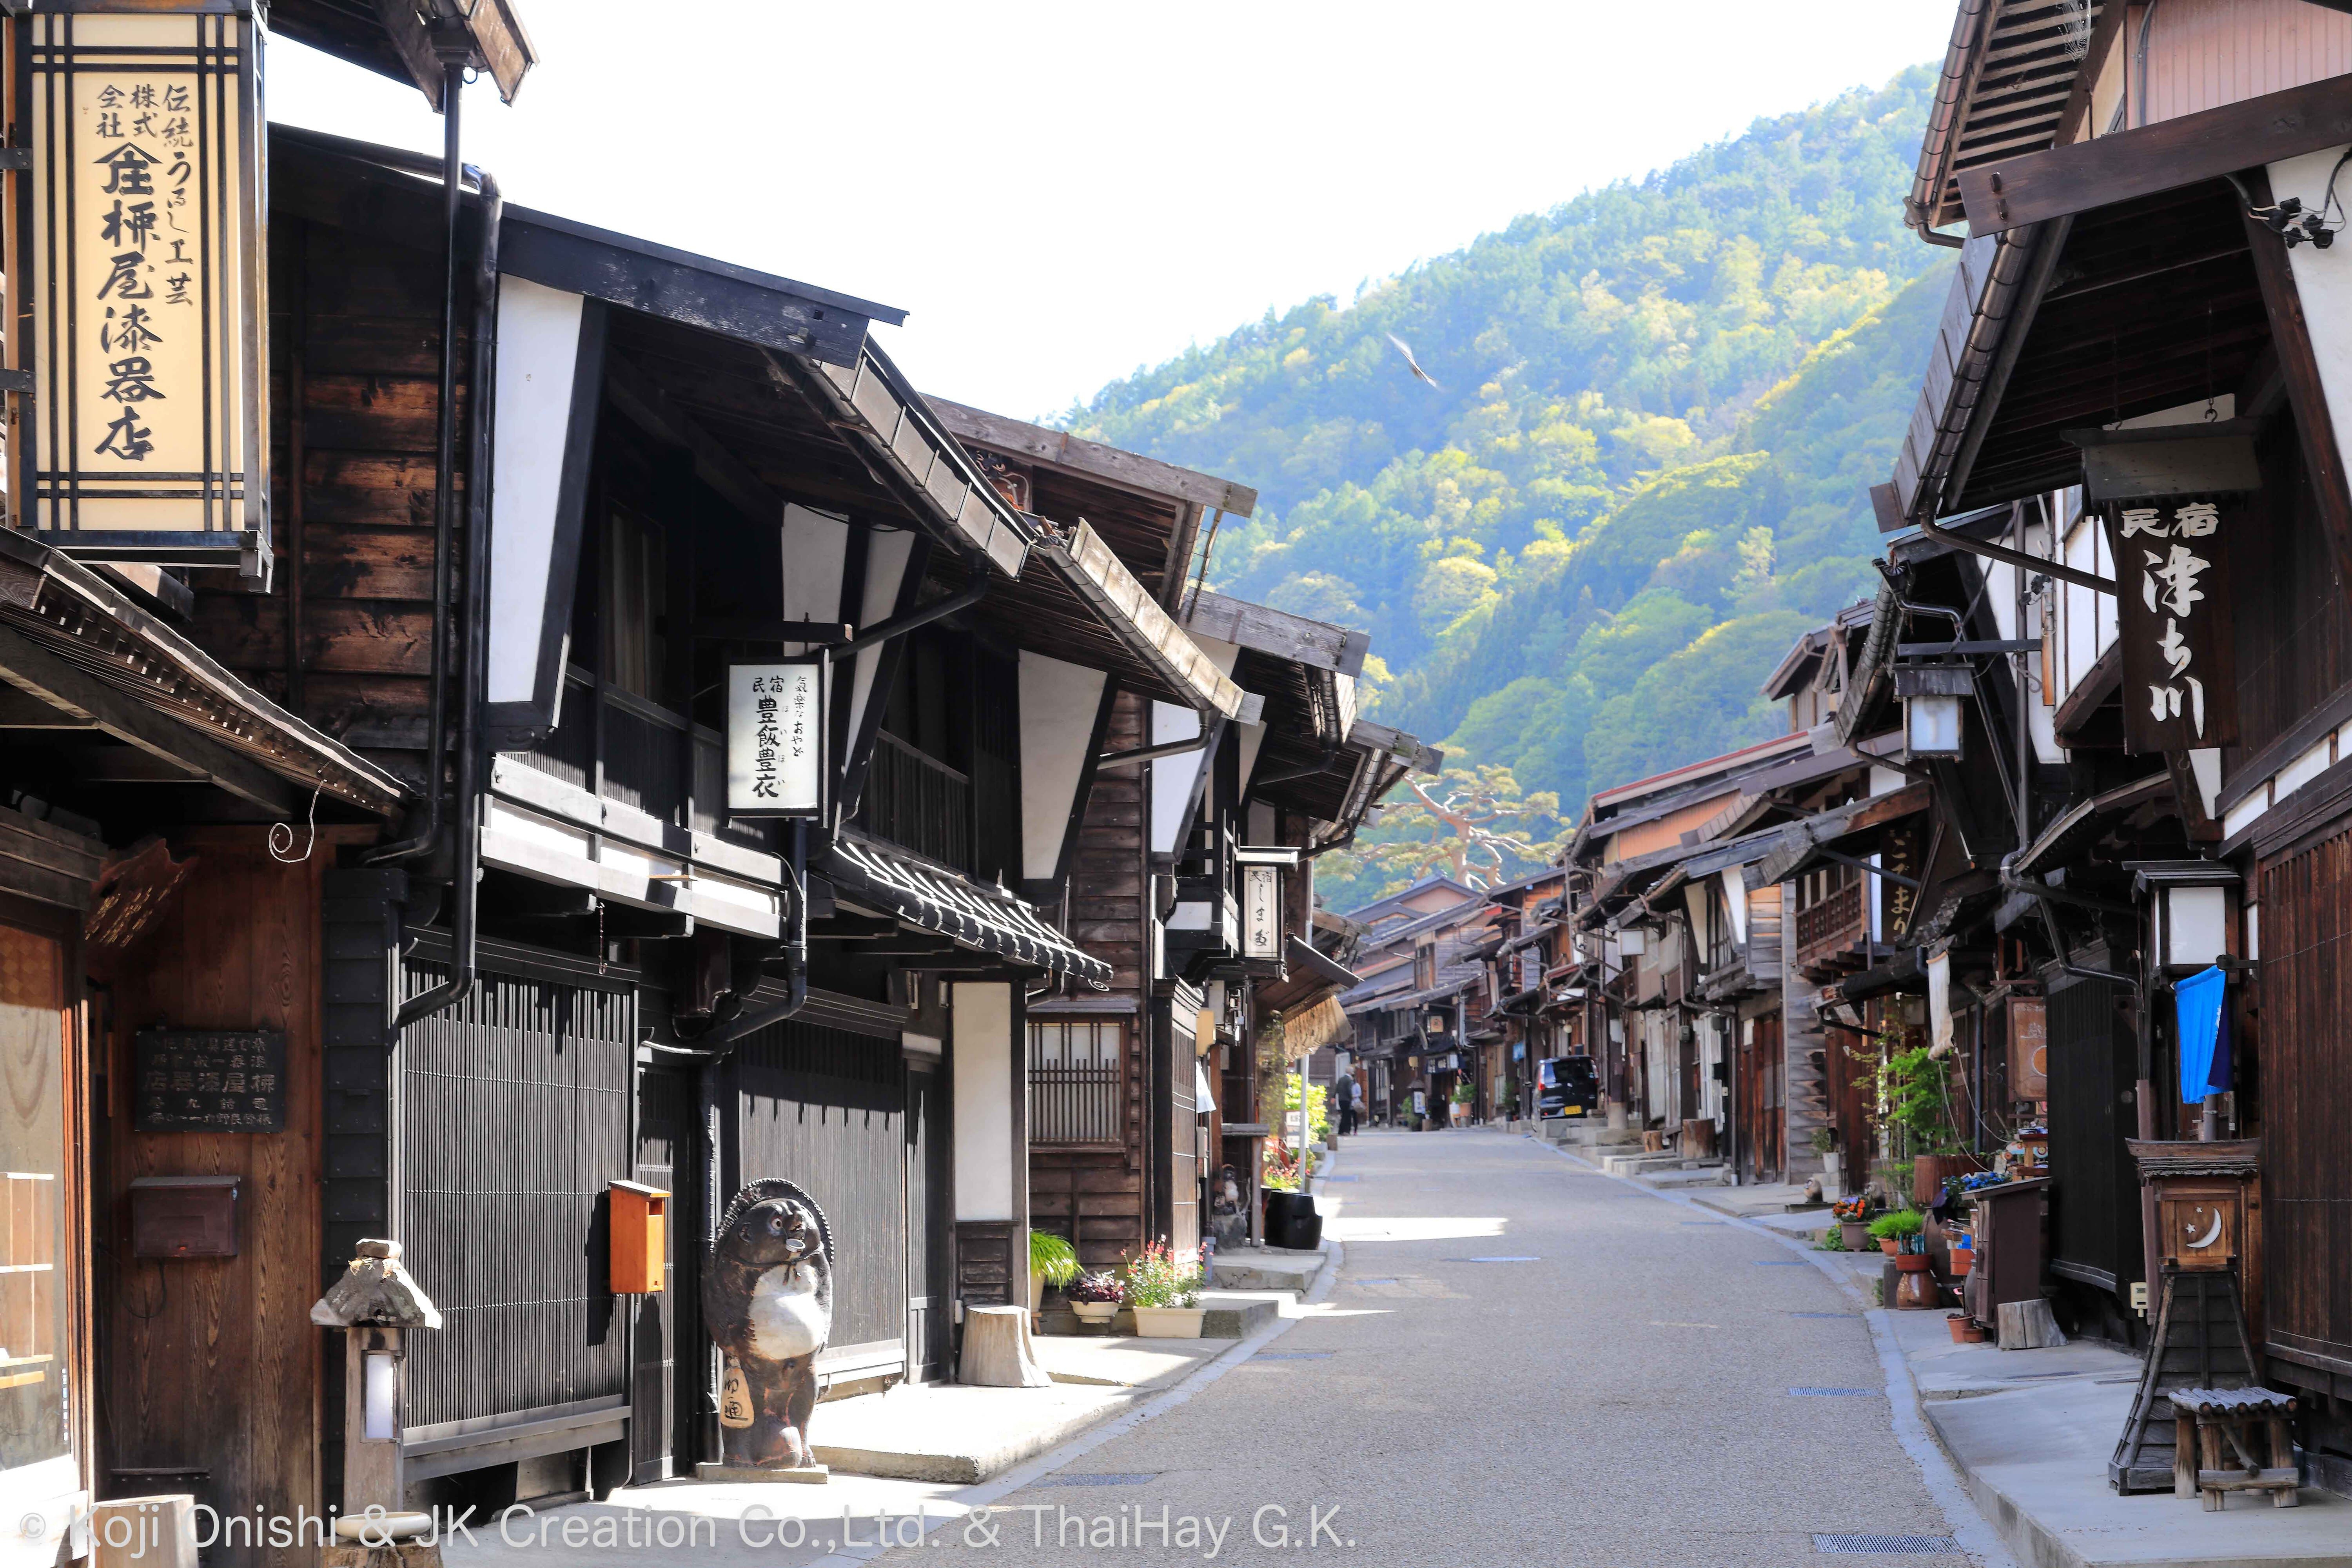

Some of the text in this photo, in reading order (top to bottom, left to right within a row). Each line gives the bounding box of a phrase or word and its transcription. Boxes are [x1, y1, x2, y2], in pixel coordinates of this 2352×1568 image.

[96, 83, 159, 139] 株式会社
[161, 83, 194, 307] 伝統うるし工芸
[2120, 503, 2220, 538] 民宿
[753, 675, 784, 693] 民宿
